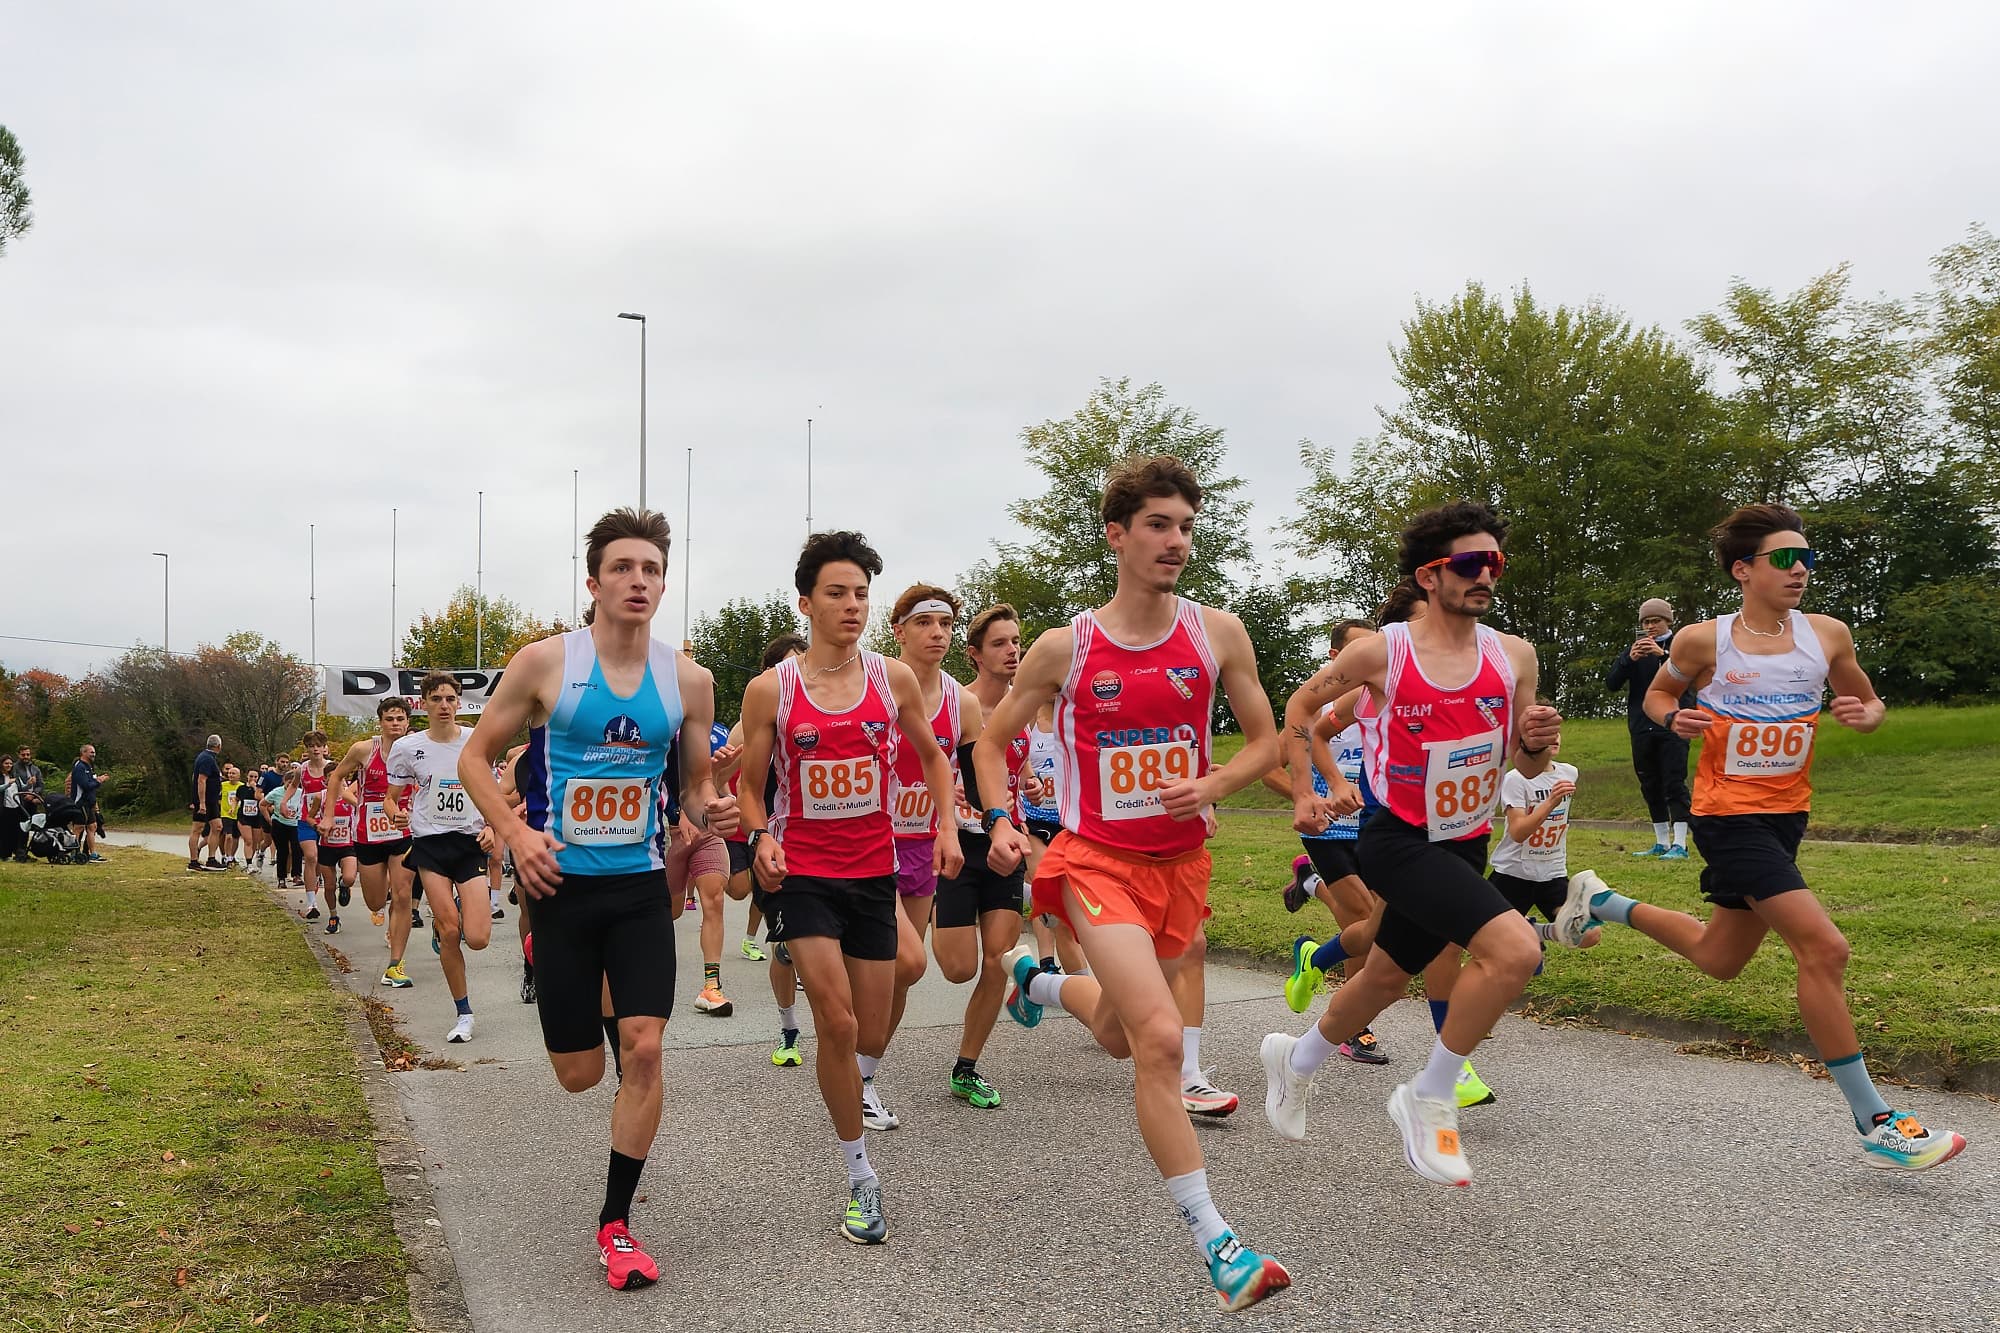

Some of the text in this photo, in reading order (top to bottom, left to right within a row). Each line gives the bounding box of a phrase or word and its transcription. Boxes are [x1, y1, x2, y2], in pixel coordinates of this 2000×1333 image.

[1094, 678, 1120, 687] SPORT
[1395, 704, 1432, 717] TEAM
[794, 730, 817, 738] SPORT
[1096, 727, 1170, 747] SUPER
[1736, 725, 1805, 757] 896
[1110, 746, 1190, 794] 889
[1737, 760, 1761, 768] Crédit
[808, 760, 874, 799] 885
[437, 792, 464, 812] 346
[1435, 768, 1498, 818] 883
[570, 785, 642, 822] 868
[813, 799, 872, 811] Crédit Mutuel
[894, 790, 932, 818] 00
[1115, 799, 1144, 809] Crédit
[574, 827, 637, 836] Crédit Mutuel
[1528, 824, 1567, 848] 857
[1878, 1135, 1912, 1154] HOKA
